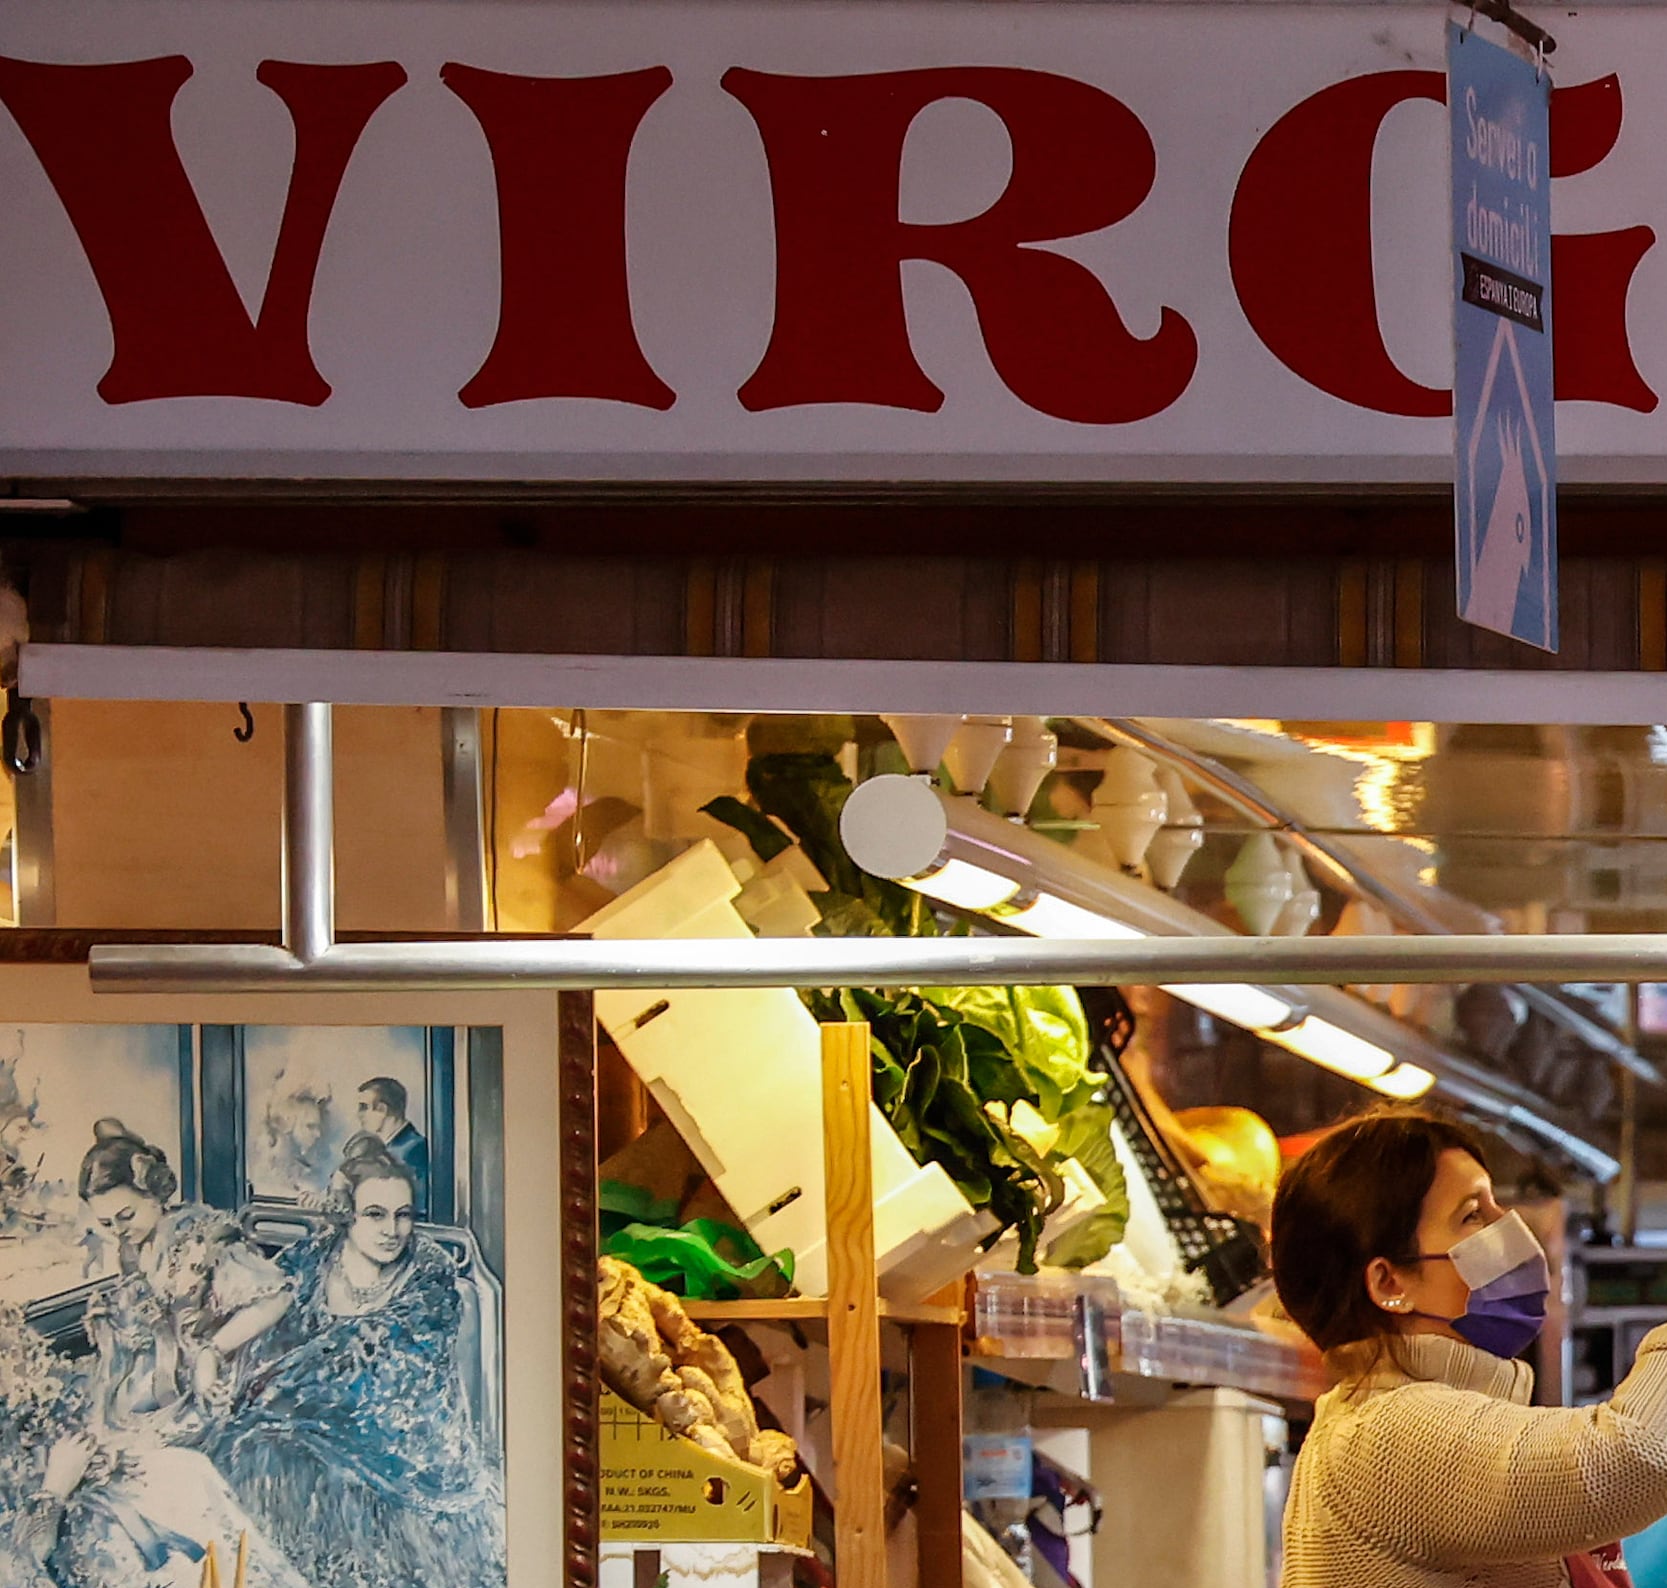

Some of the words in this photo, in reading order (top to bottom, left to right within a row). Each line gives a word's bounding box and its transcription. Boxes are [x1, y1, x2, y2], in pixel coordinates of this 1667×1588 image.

[1466, 84, 1522, 181] Servei
[1526, 140, 1538, 191] a
[1466, 179, 1539, 280] domicili
[657, 1470, 694, 1479] CHINA
